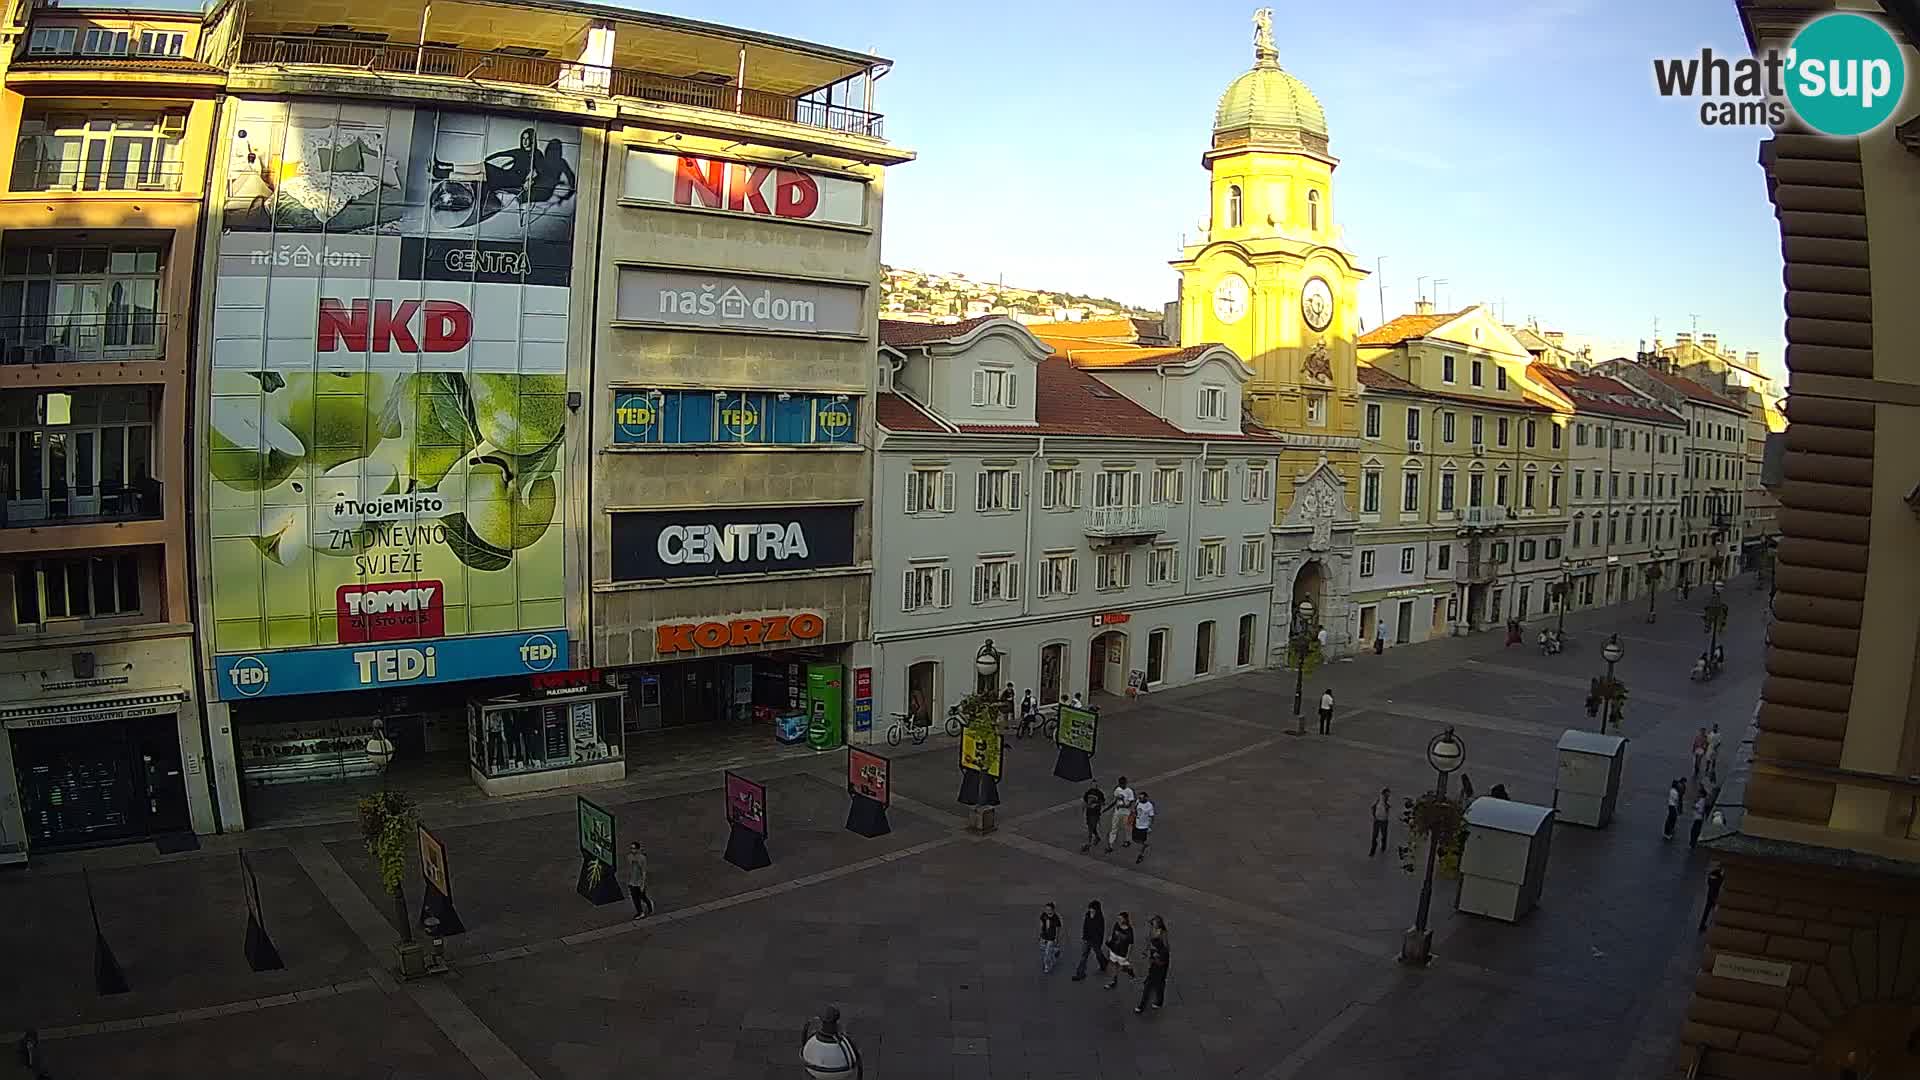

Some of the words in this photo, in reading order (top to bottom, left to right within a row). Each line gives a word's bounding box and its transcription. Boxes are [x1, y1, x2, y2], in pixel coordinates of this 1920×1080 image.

[673, 155, 820, 219] NKD
[250, 242, 290, 267] naš
[315, 245, 362, 268] dom
[444, 248, 532, 275] CENTRA
[658, 283, 716, 316] naš
[751, 289, 816, 323] dom
[316, 296, 474, 354] NKD
[616, 407, 656, 426] TEDi
[721, 408, 759, 426] TEDi
[333, 496, 443, 517] #TvojeMisto
[329, 527, 354, 550] ZA
[362, 523, 448, 549] DNEVNO
[656, 521, 810, 565] CENTRA
[355, 548, 424, 576] SVJEŽE
[344, 587, 436, 616] TOMMY
[655, 612, 825, 654] KORZO
[353, 646, 437, 684] TEDi
[519, 643, 558, 662] TEDi
[229, 665, 270, 686] TEDi
